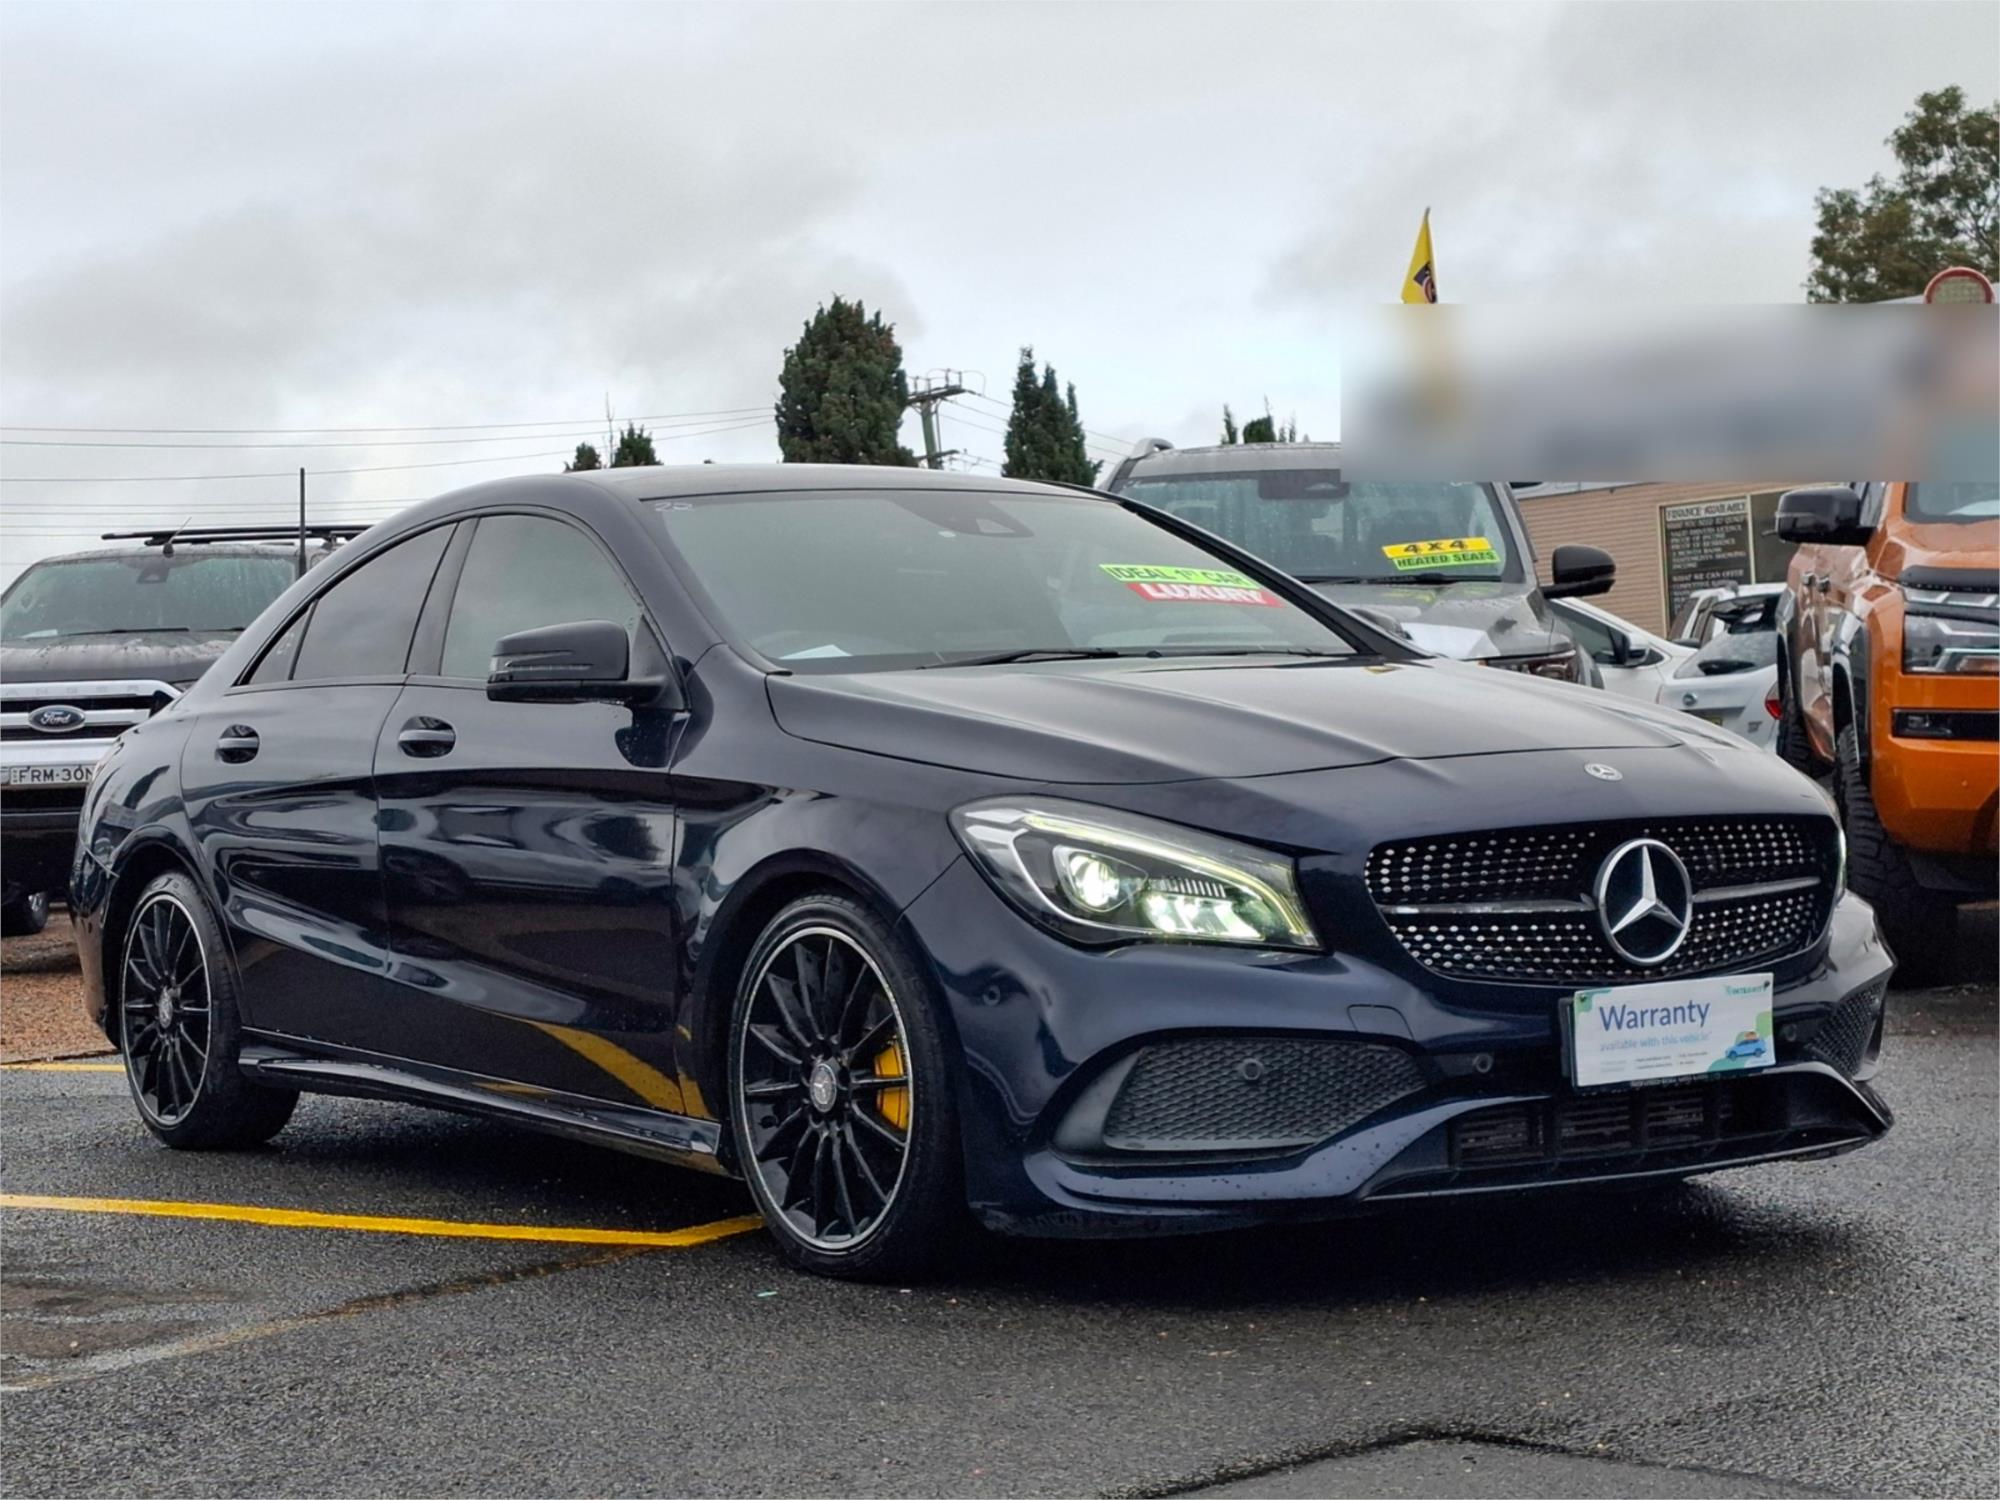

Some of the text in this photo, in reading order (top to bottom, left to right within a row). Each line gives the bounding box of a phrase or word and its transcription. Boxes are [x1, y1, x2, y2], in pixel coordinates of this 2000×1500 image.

[1404, 544, 1418, 553] 4
[1450, 540, 1465, 549] 4
[1397, 551, 1496, 567] HEATED SEATS
[1105, 567, 1177, 580] IDEAL
[1139, 583, 1267, 604] LUXURY
[40, 711, 71, 725] Ford
[1600, 1000, 1710, 1032] Warranty
